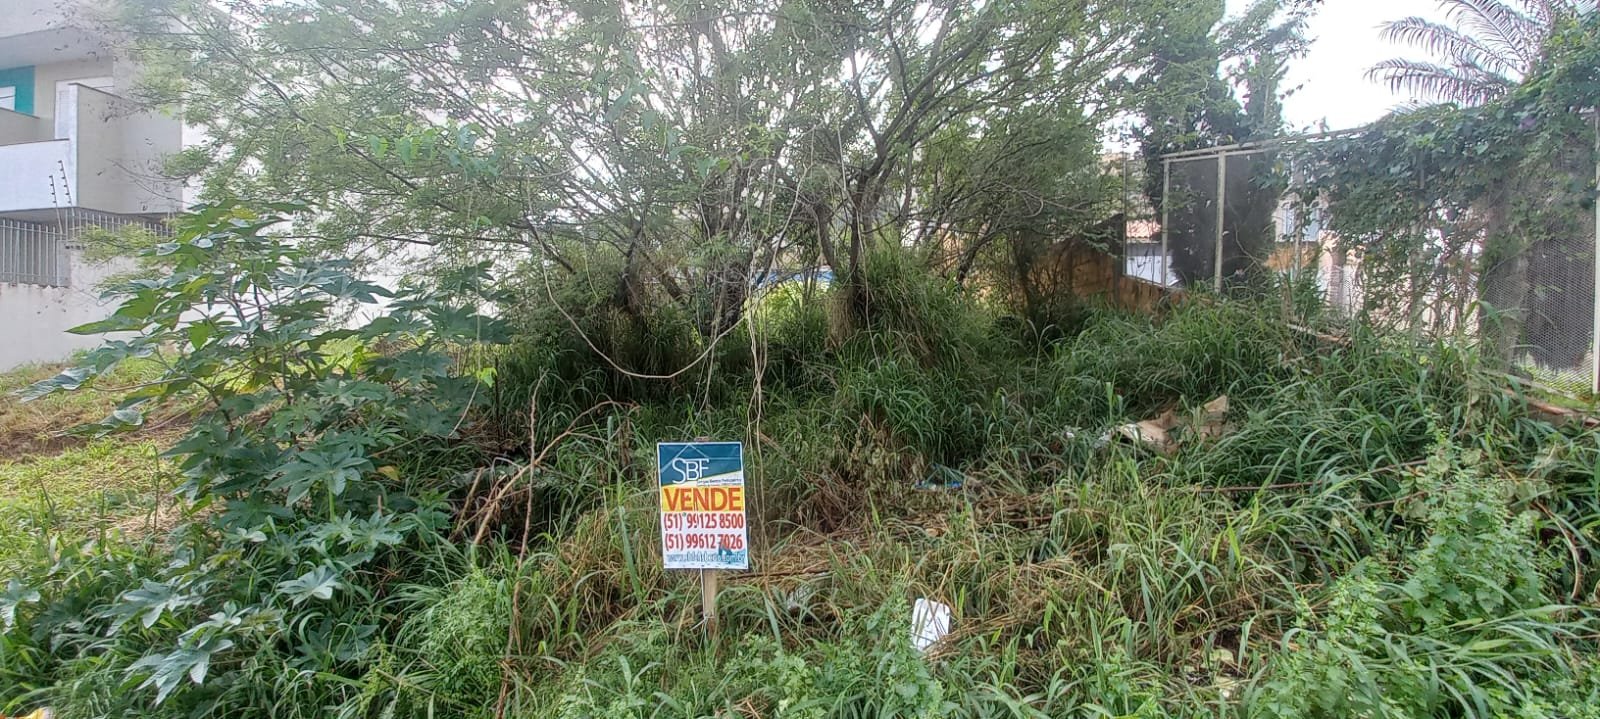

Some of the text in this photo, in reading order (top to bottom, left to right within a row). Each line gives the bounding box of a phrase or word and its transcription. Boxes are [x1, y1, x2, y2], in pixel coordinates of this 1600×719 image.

[672, 458, 709, 484] SBF
[664, 487, 741, 511] VENDE
[664, 513, 744, 531] (51) 99125 8500
[665, 533, 743, 551] (51) 99612 7026
